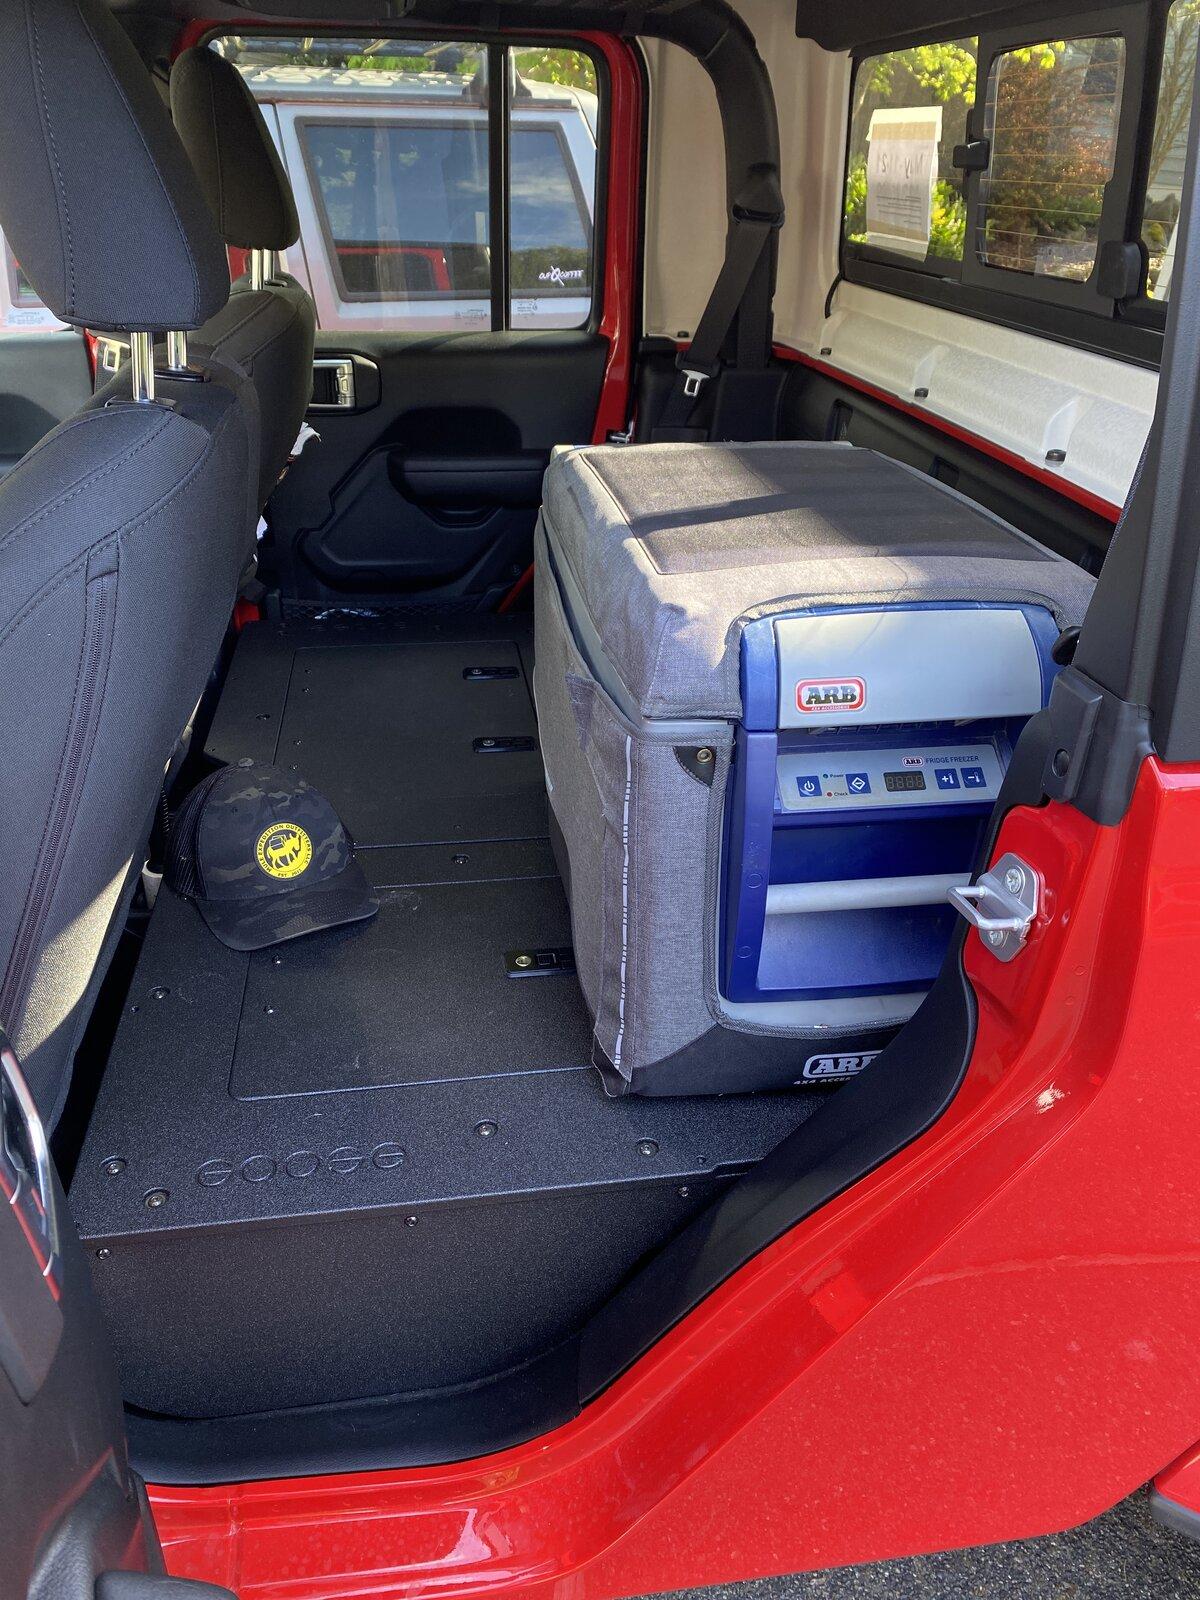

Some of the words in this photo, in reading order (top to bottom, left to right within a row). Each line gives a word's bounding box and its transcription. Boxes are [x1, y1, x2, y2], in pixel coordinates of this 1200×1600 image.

[805, 685, 857, 705] ARB
[950, 755, 979, 763] FREEZER
[258, 824, 283, 855] EXPEDITION
[286, 824, 311, 852] OUTFITTERS
[260, 857, 271, 872] MULE
